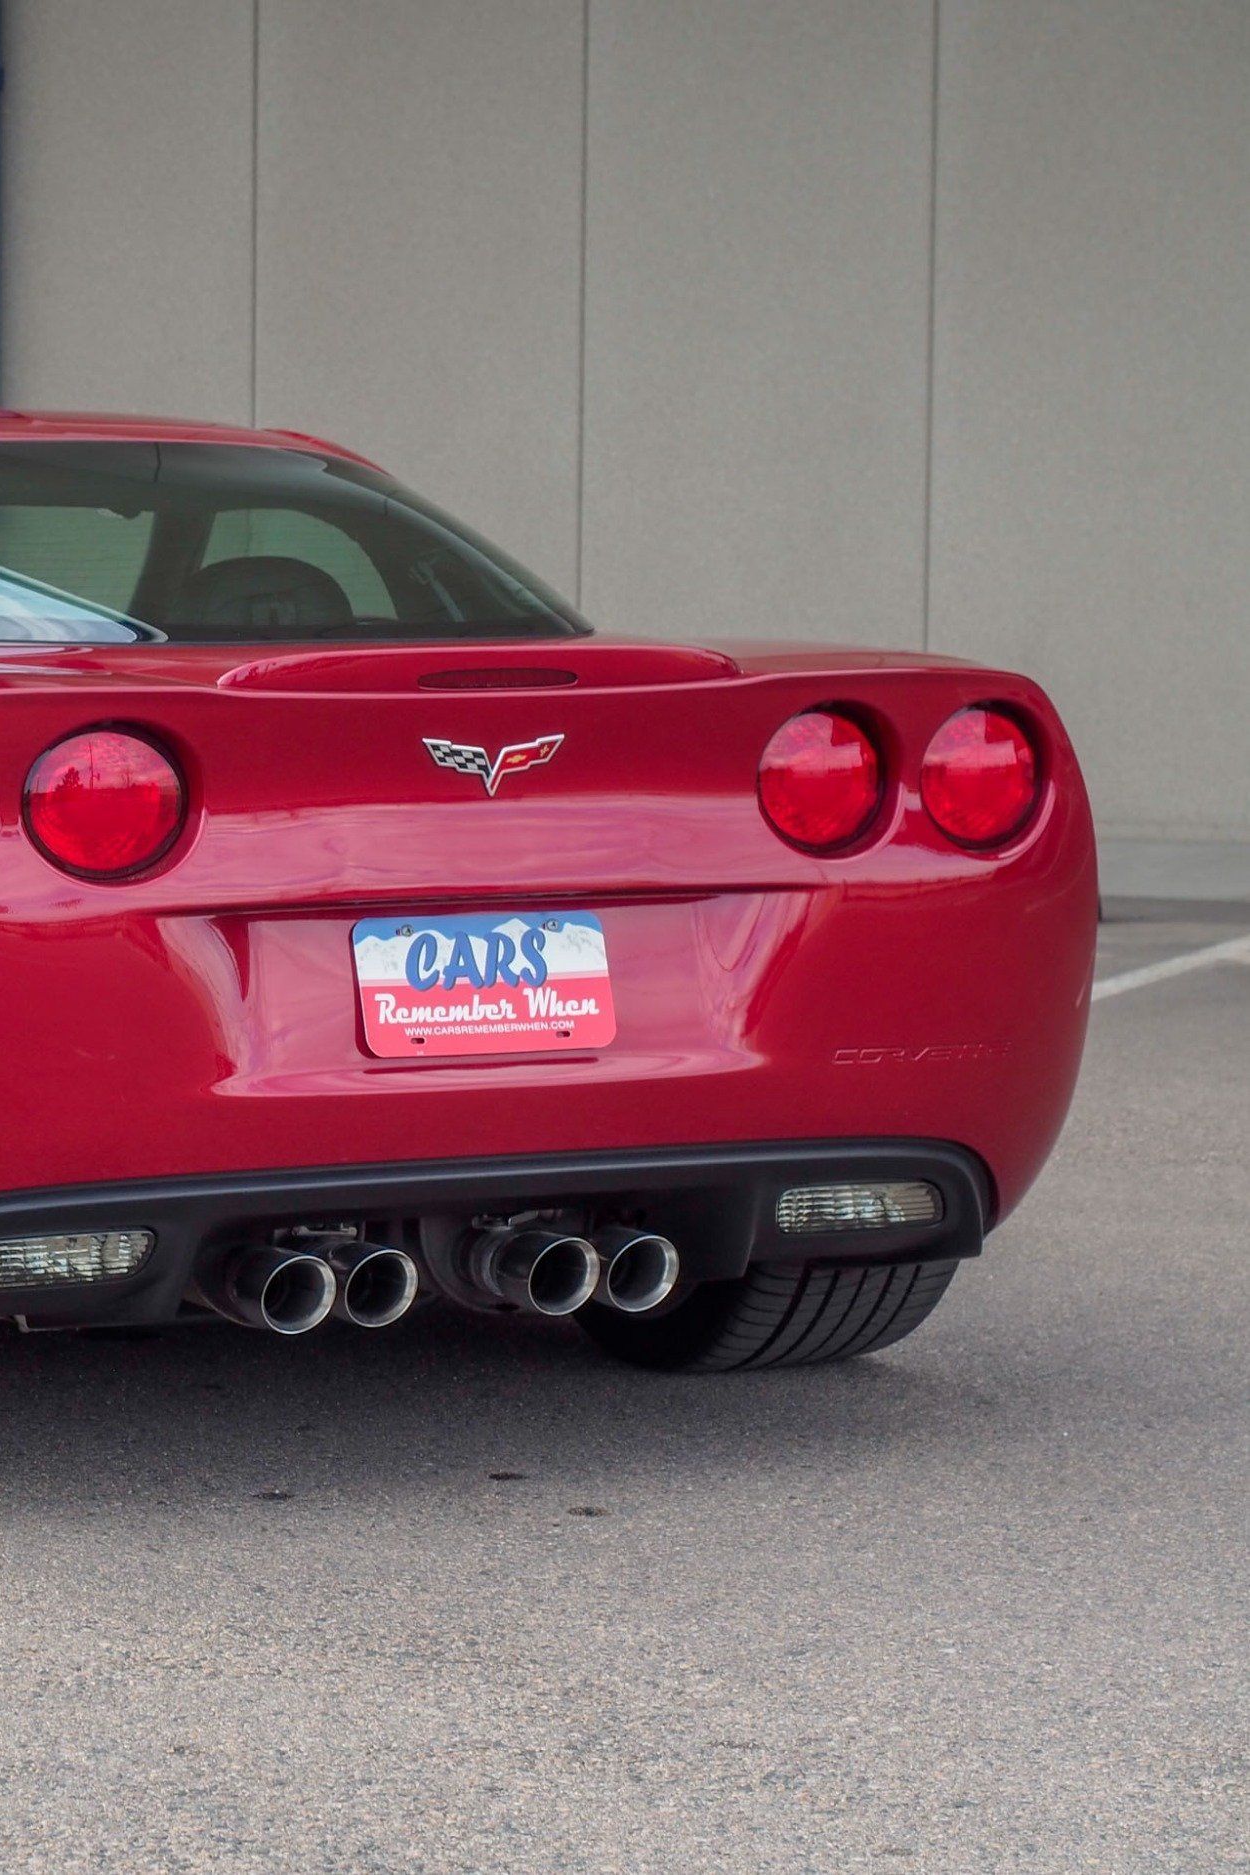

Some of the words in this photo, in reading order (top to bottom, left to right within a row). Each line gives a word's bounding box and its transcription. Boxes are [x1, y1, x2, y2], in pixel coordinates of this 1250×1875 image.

[405, 927, 549, 991] CARS
[374, 993, 517, 1025] Remember
[523, 987, 600, 1018] When
[405, 1020, 575, 1037] WWW.CARSREMEMBERWHEN.COM
[833, 1042, 1013, 1065] CORVE
